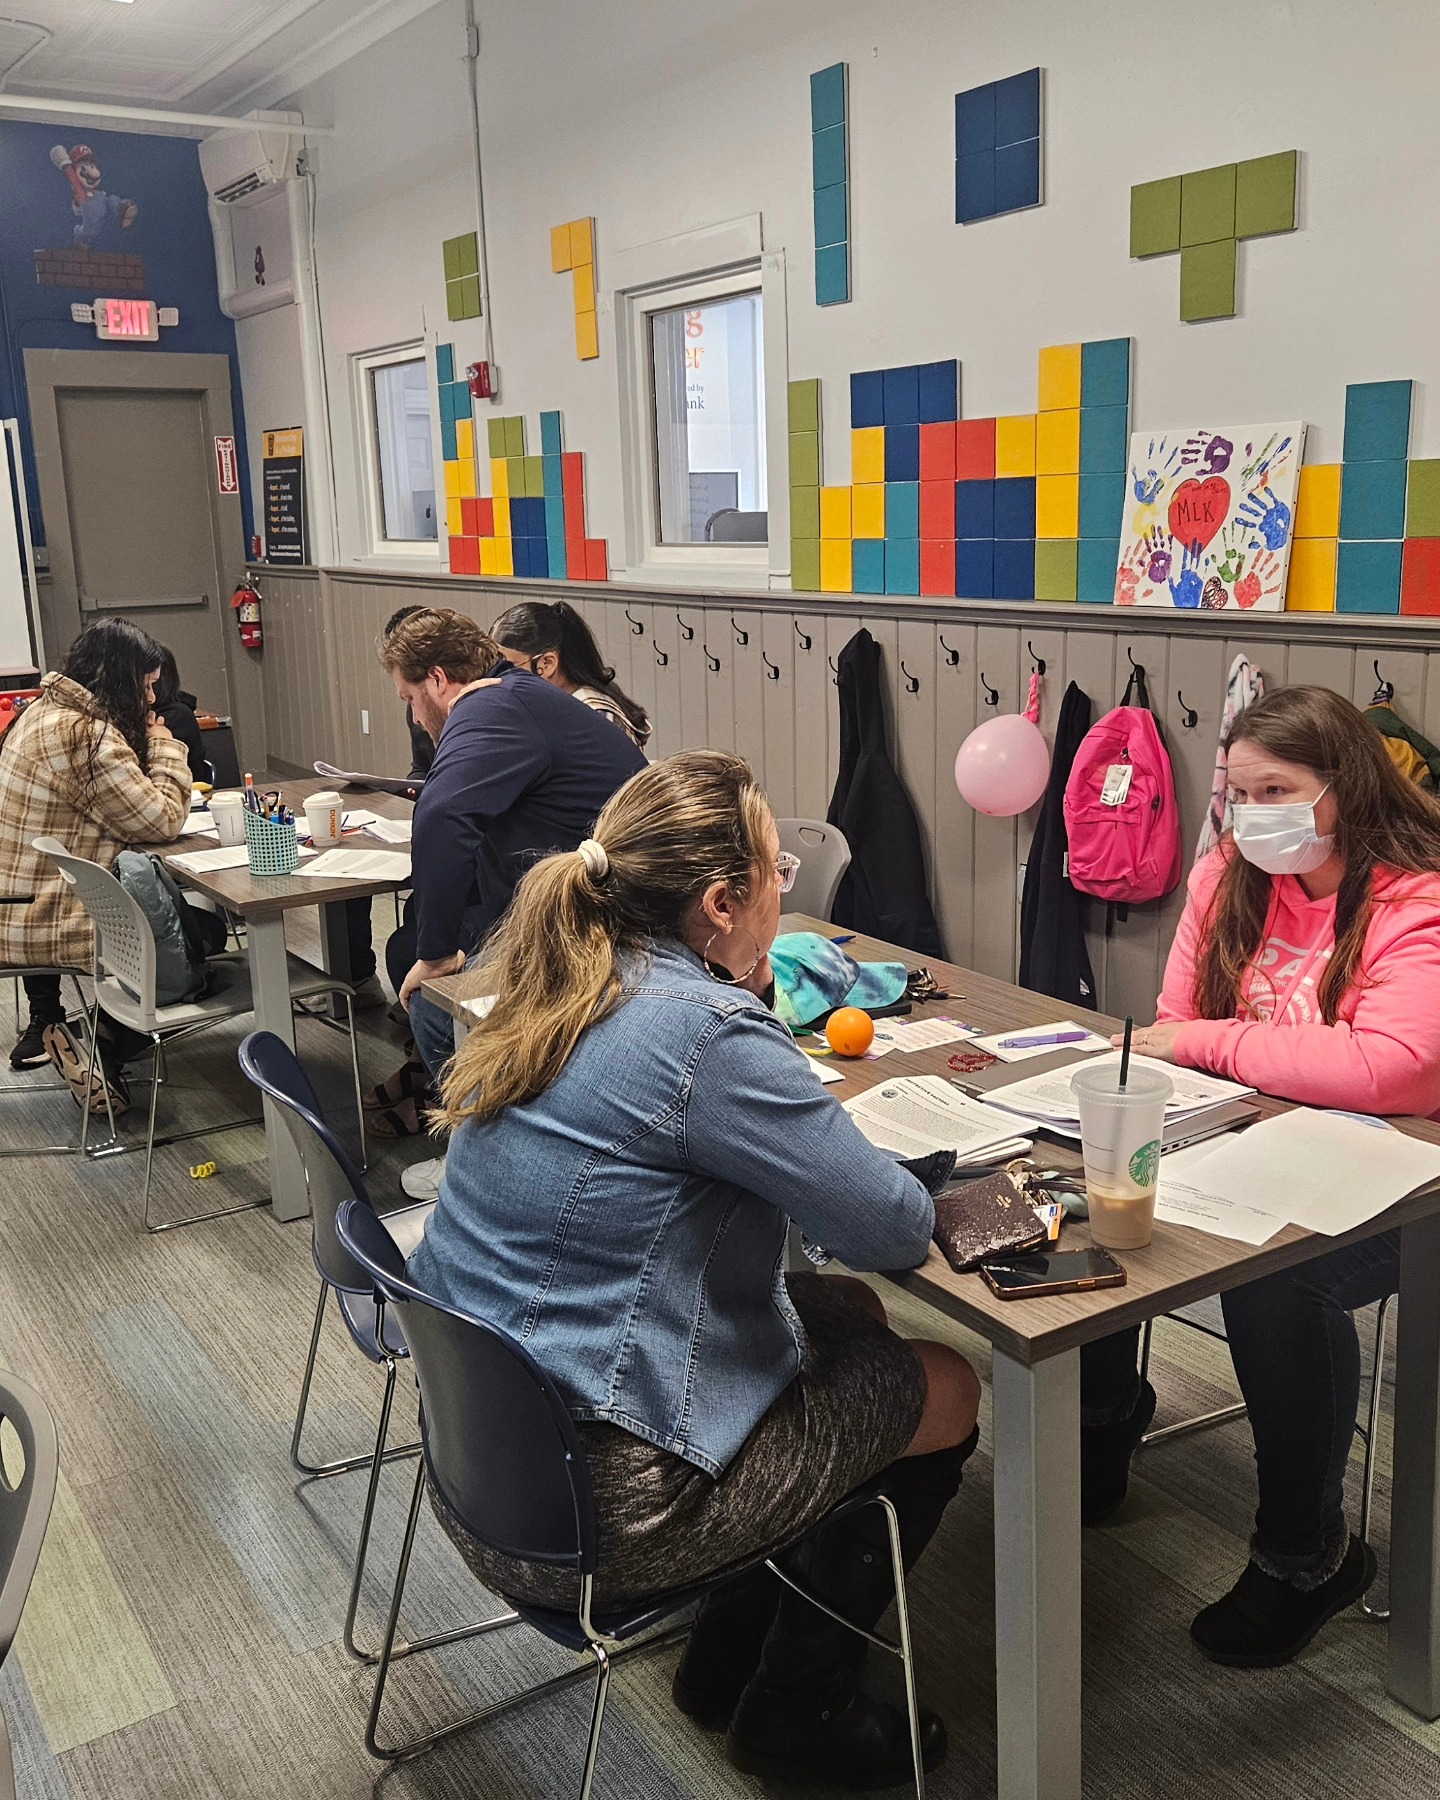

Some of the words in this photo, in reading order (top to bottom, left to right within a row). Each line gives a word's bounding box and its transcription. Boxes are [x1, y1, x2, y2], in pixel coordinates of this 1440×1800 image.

[106, 299, 149, 335] EXIT
[696, 384, 704, 394] by
[1178, 498, 1215, 526] MLK
